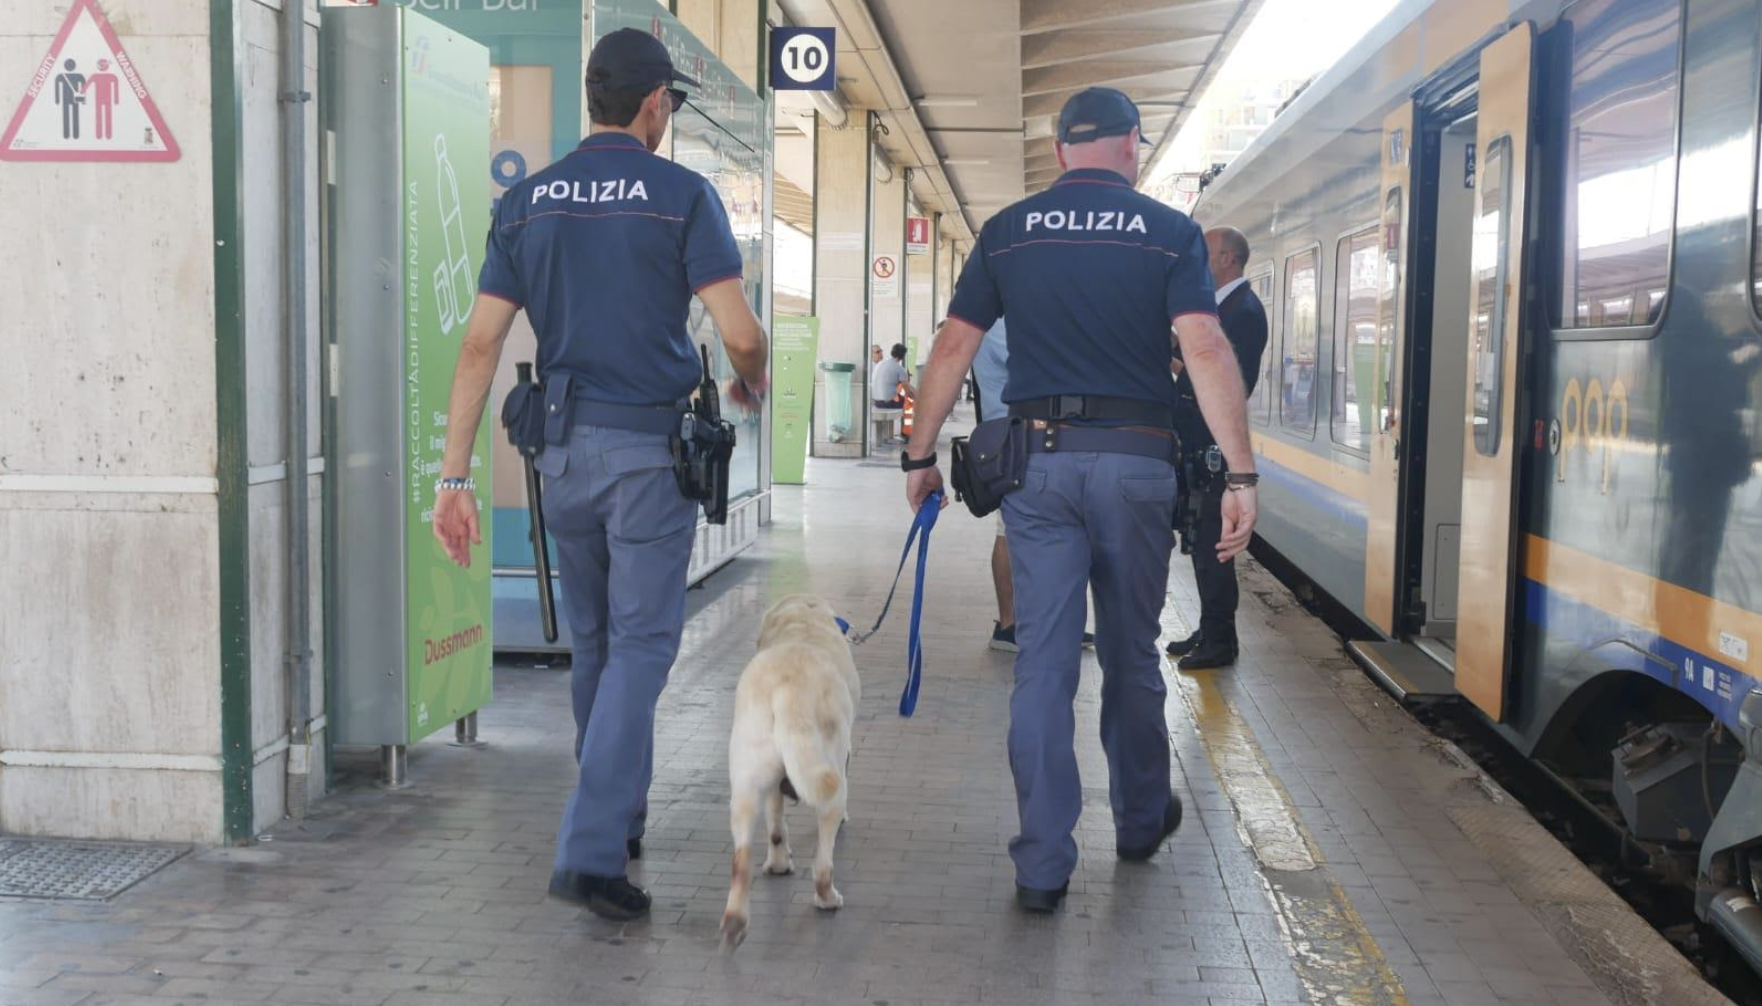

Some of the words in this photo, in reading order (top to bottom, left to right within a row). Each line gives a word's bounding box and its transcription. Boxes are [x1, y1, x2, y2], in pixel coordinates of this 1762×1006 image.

[27, 53, 56, 98] SECURITY
[116, 51, 148, 99] WARNING
[788, 46, 822, 70] 10
[531, 178, 649, 205] POLIZIA
[1025, 210, 1148, 234] POLIZIA
[424, 623, 482, 666] Dussmann
